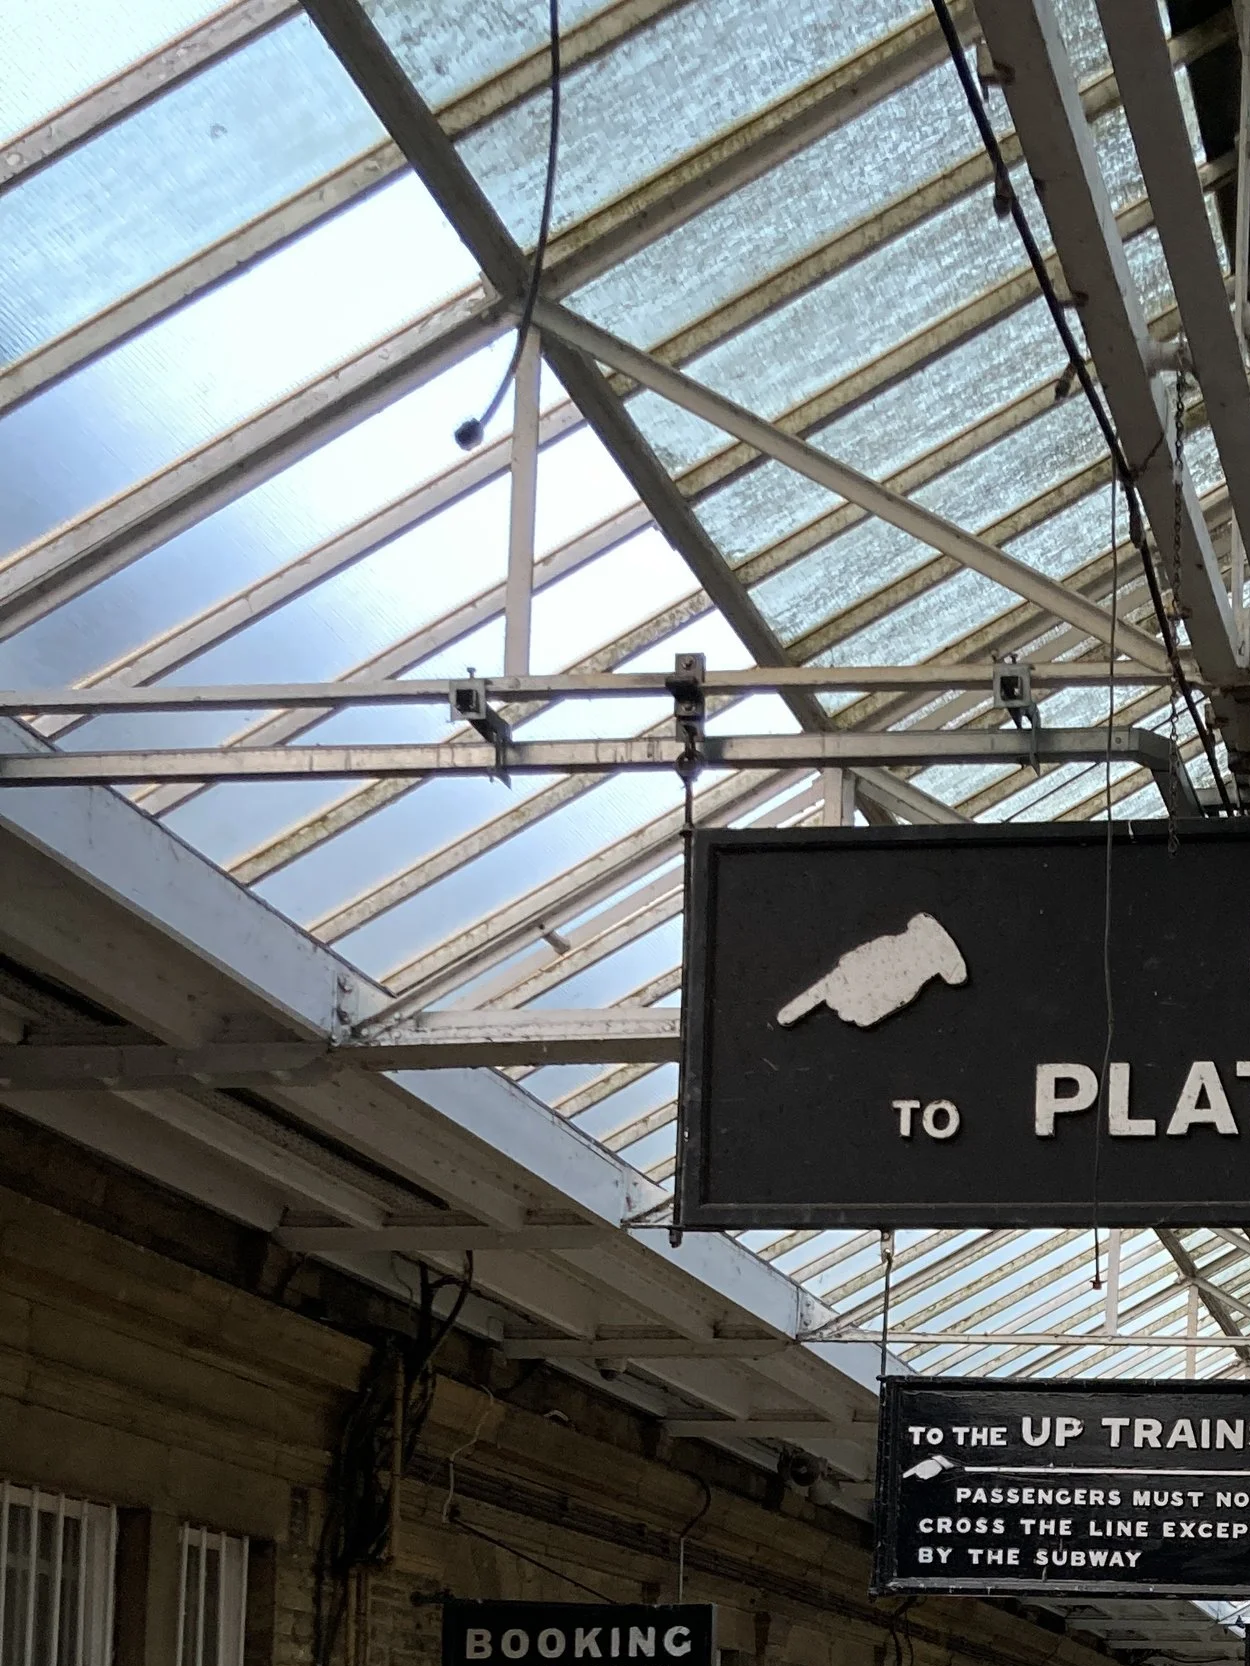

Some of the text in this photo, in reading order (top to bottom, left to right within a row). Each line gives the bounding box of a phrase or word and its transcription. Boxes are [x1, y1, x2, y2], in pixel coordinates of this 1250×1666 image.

[892, 1100, 960, 1139] TO
[907, 1425, 944, 1446] TO
[952, 1426, 1007, 1447] THE
[1021, 1416, 1084, 1448] UP
[956, 1487, 1121, 1507] PASSENGERS
[1132, 1489, 1204, 1508] MUST
[918, 1516, 1005, 1535] CROSS
[1019, 1518, 1072, 1536] THE
[1089, 1519, 1149, 1538] LINE
[917, 1546, 1142, 1568] BY THE SUBWAY
[465, 1625, 692, 1660] BOOKING
